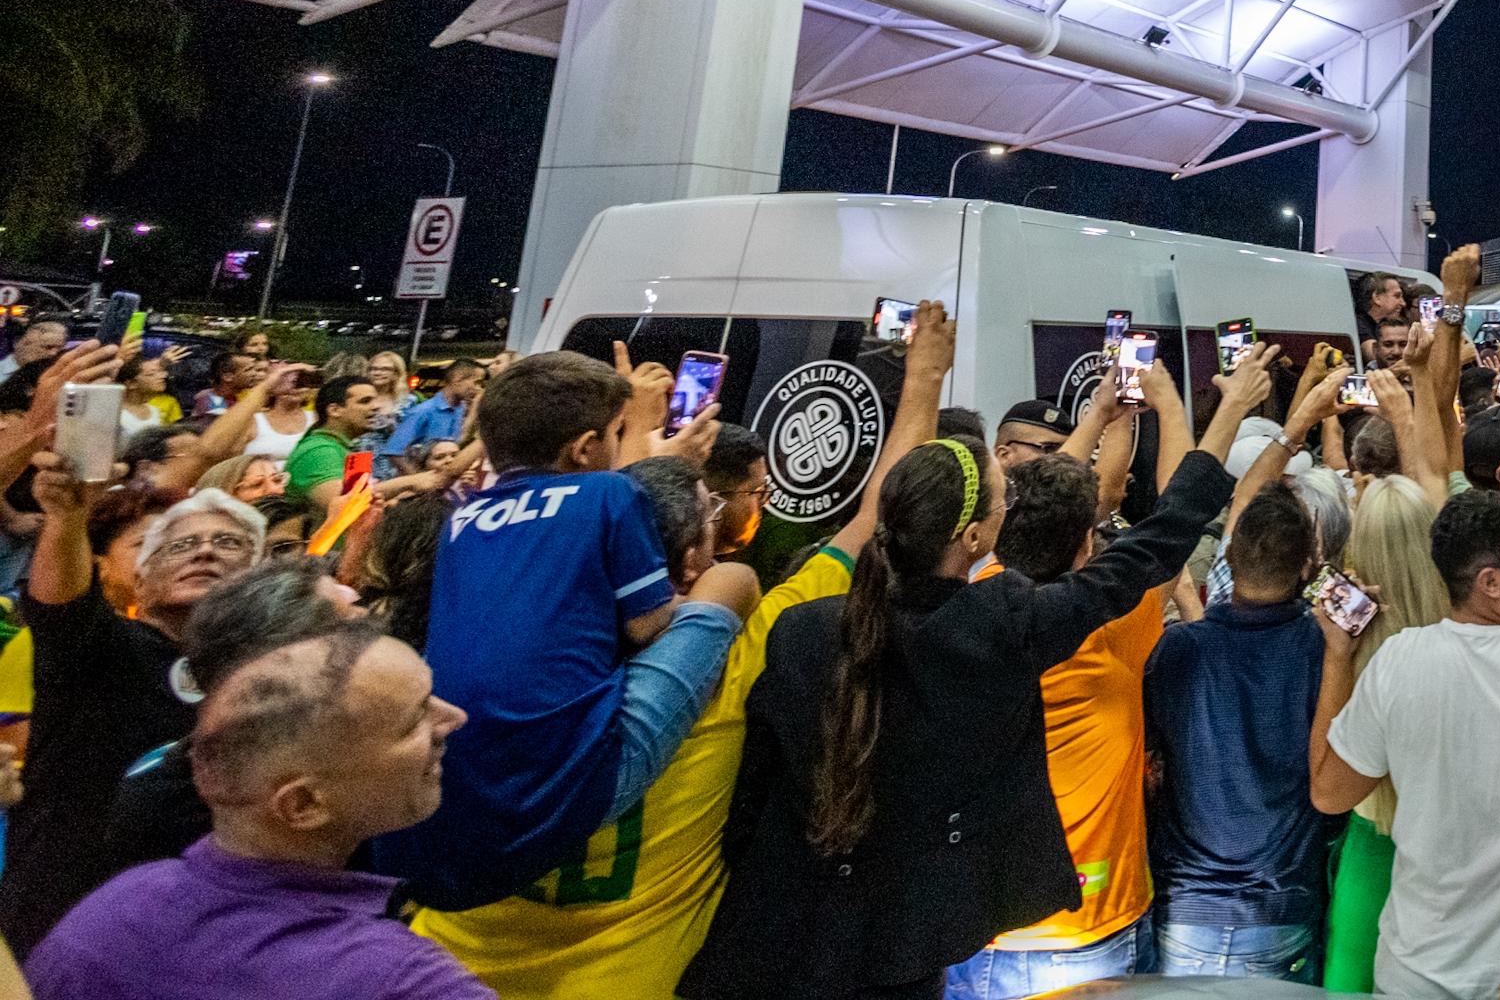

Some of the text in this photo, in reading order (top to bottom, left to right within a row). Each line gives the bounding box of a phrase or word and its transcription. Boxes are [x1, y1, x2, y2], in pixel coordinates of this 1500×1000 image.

[423, 215, 446, 245] E
[777, 366, 878, 446] QUALIDADE LUCK
[449, 485, 580, 542] VOLT
[798, 494, 832, 515] 1960
